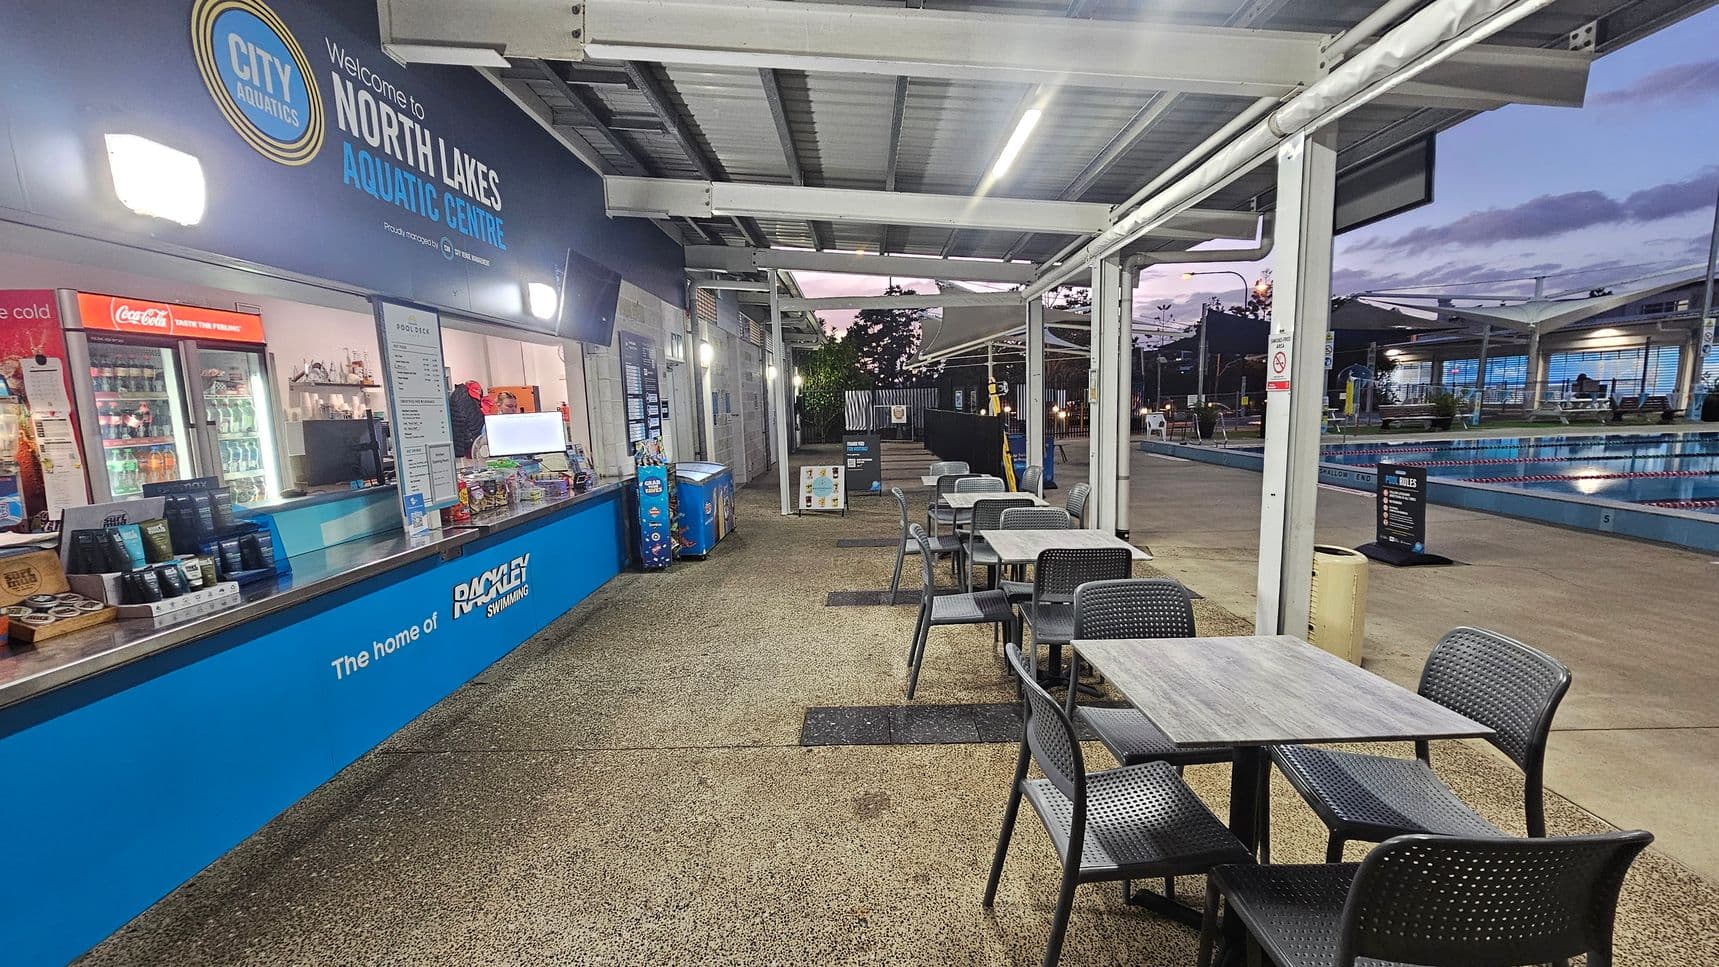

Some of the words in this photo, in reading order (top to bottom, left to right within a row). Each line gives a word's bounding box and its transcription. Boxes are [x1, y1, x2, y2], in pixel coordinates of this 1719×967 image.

[228, 32, 291, 103] CITY
[325, 36, 407, 108] Welcome
[410, 95, 425, 120] to
[237, 82, 299, 127] AQUATICS
[332, 71, 435, 177] NORTH
[438, 137, 502, 211] LAKES
[343, 141, 439, 222] AQUATIC
[444, 192, 507, 250] CENTRE
[383, 221, 406, 238] Proudly
[406, 231, 432, 247] managed
[432, 239, 439, 250] by
[13, 303, 51, 319] cold
[115, 305, 168, 328] Coca-Cola
[174, 318, 198, 328] TASTE
[199, 320, 212, 330] THE
[212, 322, 241, 332] FEELING
[396, 323, 414, 333] POOL
[1319, 468, 1349, 479] SHALLOW
[1356, 473, 1371, 483] END
[1399, 476, 1417, 488] RULES
[453, 553, 530, 619] RACKLEY
[486, 584, 529, 618] SWIMMING
[331, 651, 369, 680] The
[373, 625, 420, 660] home
[423, 611, 438, 634] of
